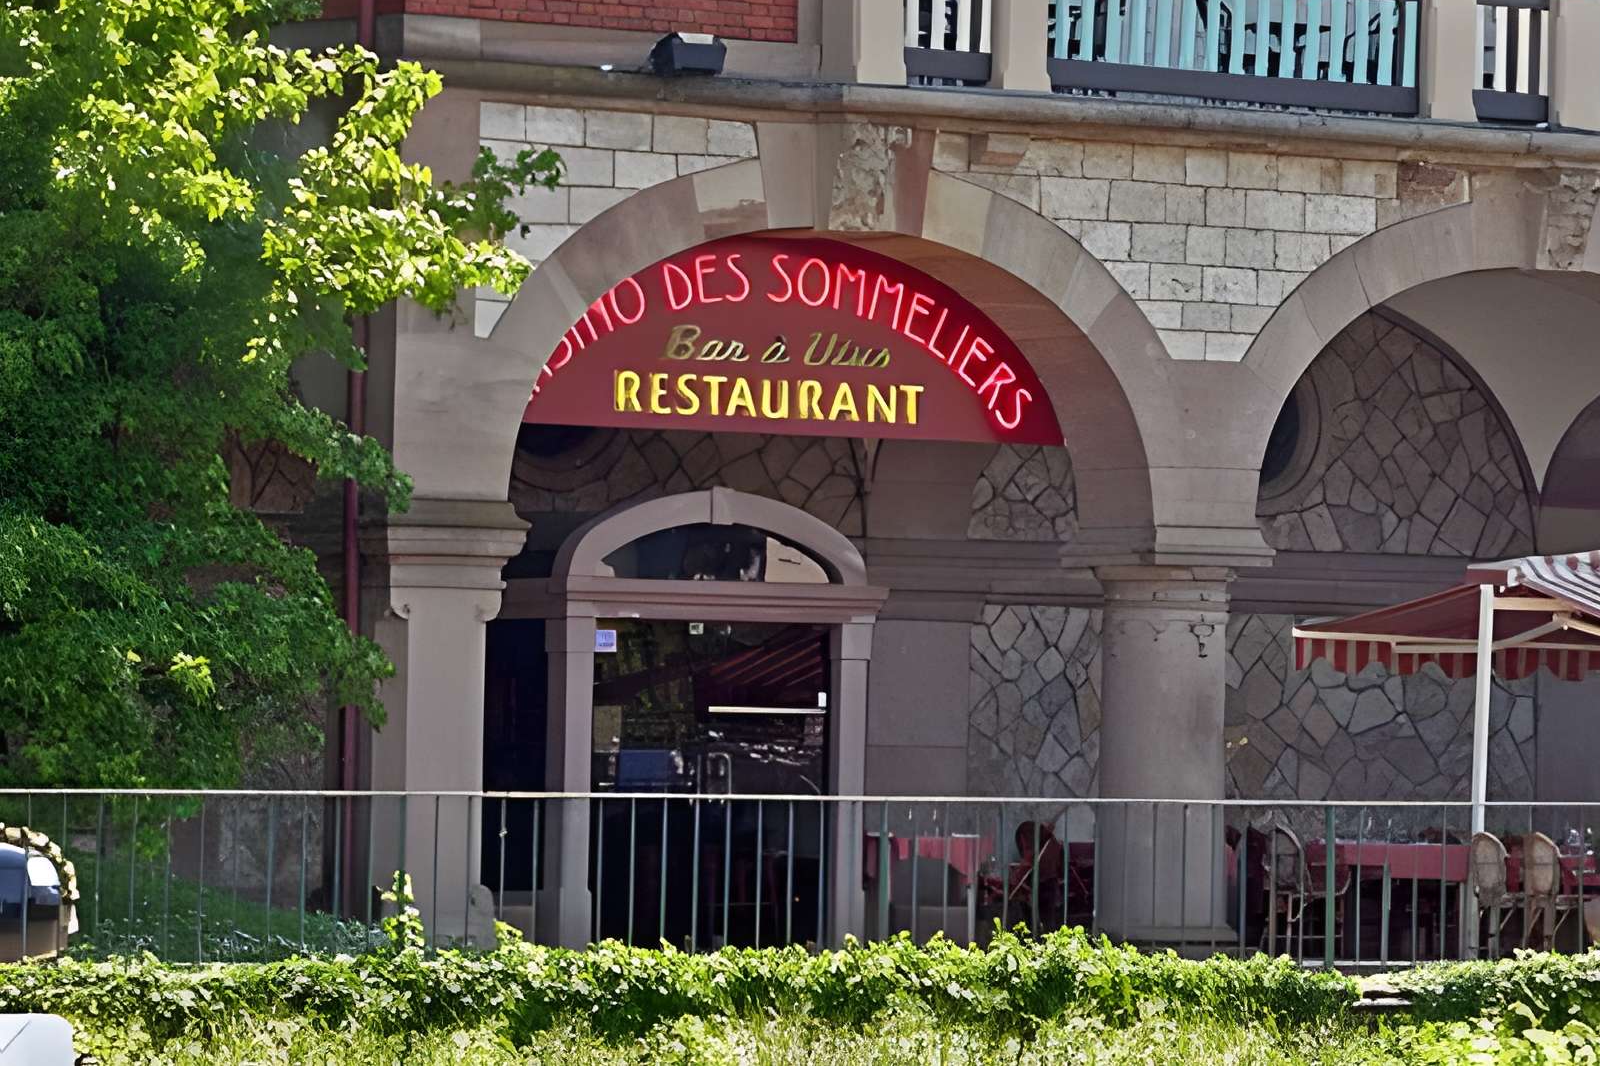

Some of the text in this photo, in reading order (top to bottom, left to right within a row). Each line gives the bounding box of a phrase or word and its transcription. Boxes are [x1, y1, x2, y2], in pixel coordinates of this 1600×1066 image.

[663, 254, 750, 310] DES
[767, 254, 1033, 430] SOMMELIERS
[664, 324, 750, 362] Bar
[614, 369, 925, 425] RESTAURANT
